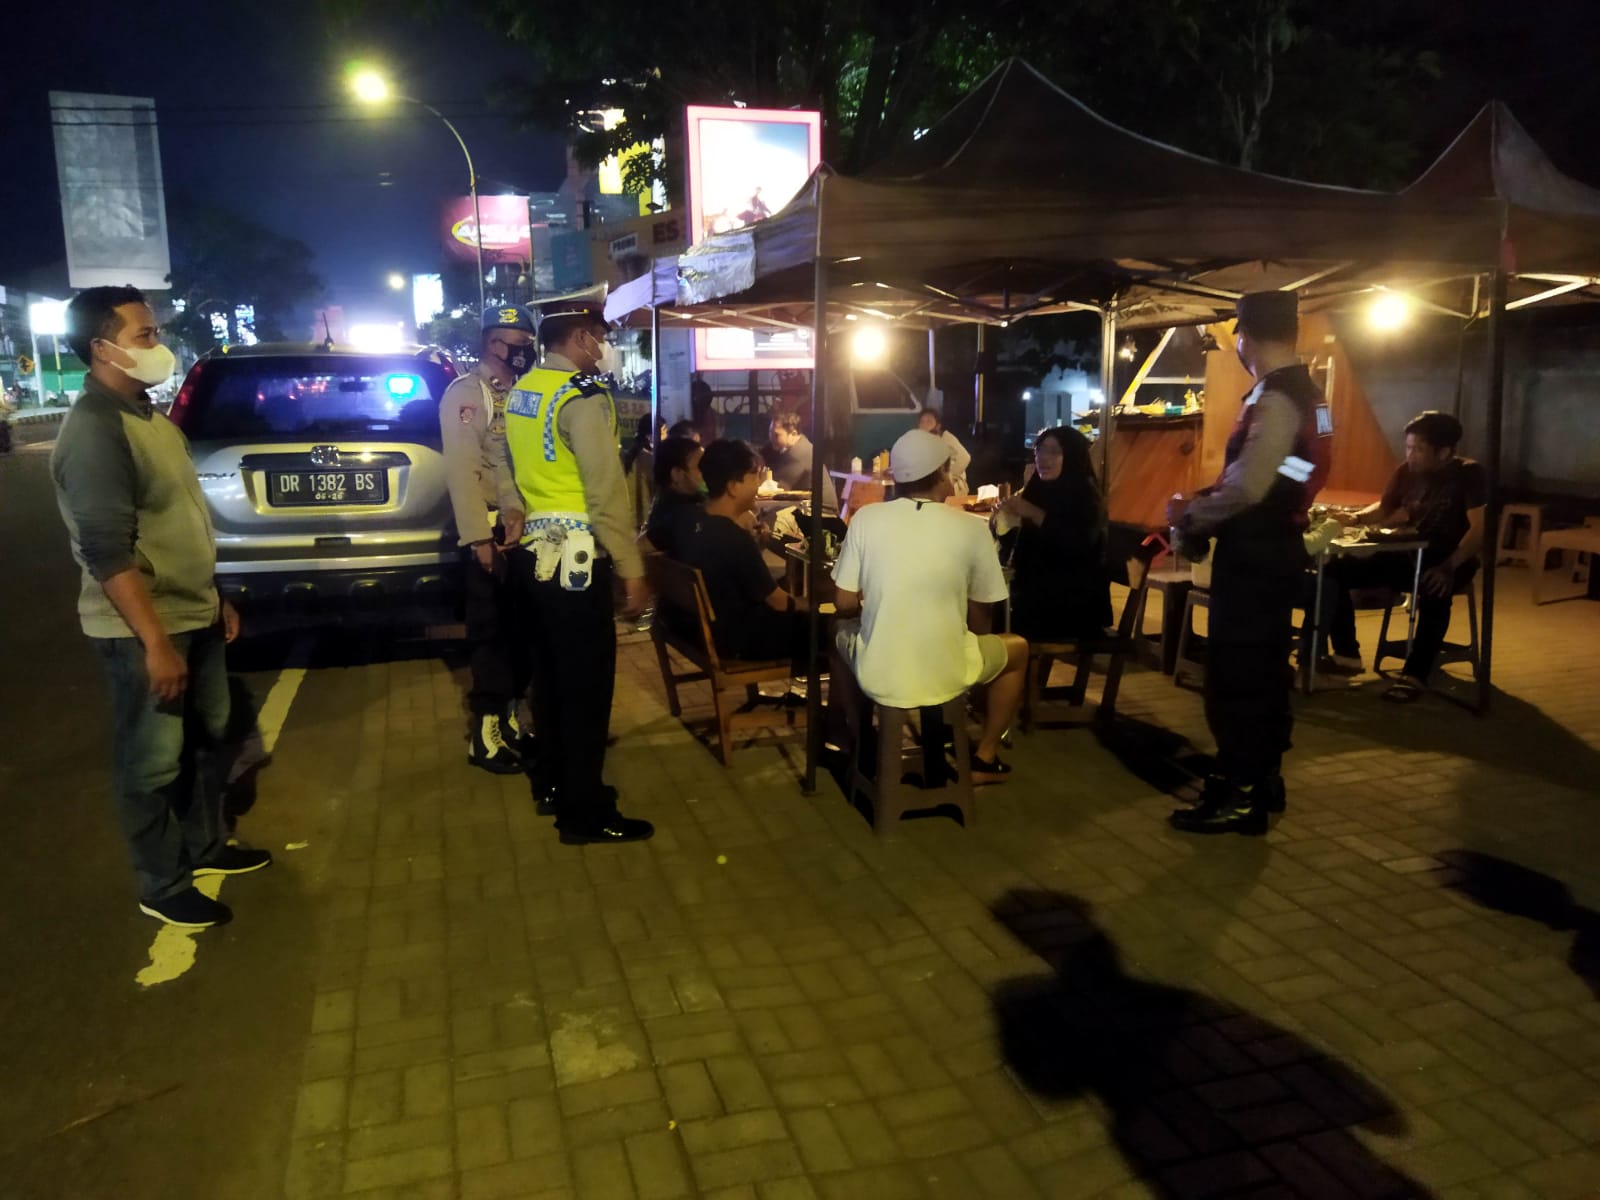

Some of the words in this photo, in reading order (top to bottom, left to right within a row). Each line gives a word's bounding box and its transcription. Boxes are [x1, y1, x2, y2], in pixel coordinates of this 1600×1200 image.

[280, 474, 300, 492] DR
[309, 474, 346, 491] 1382
[354, 473, 375, 491] BS
